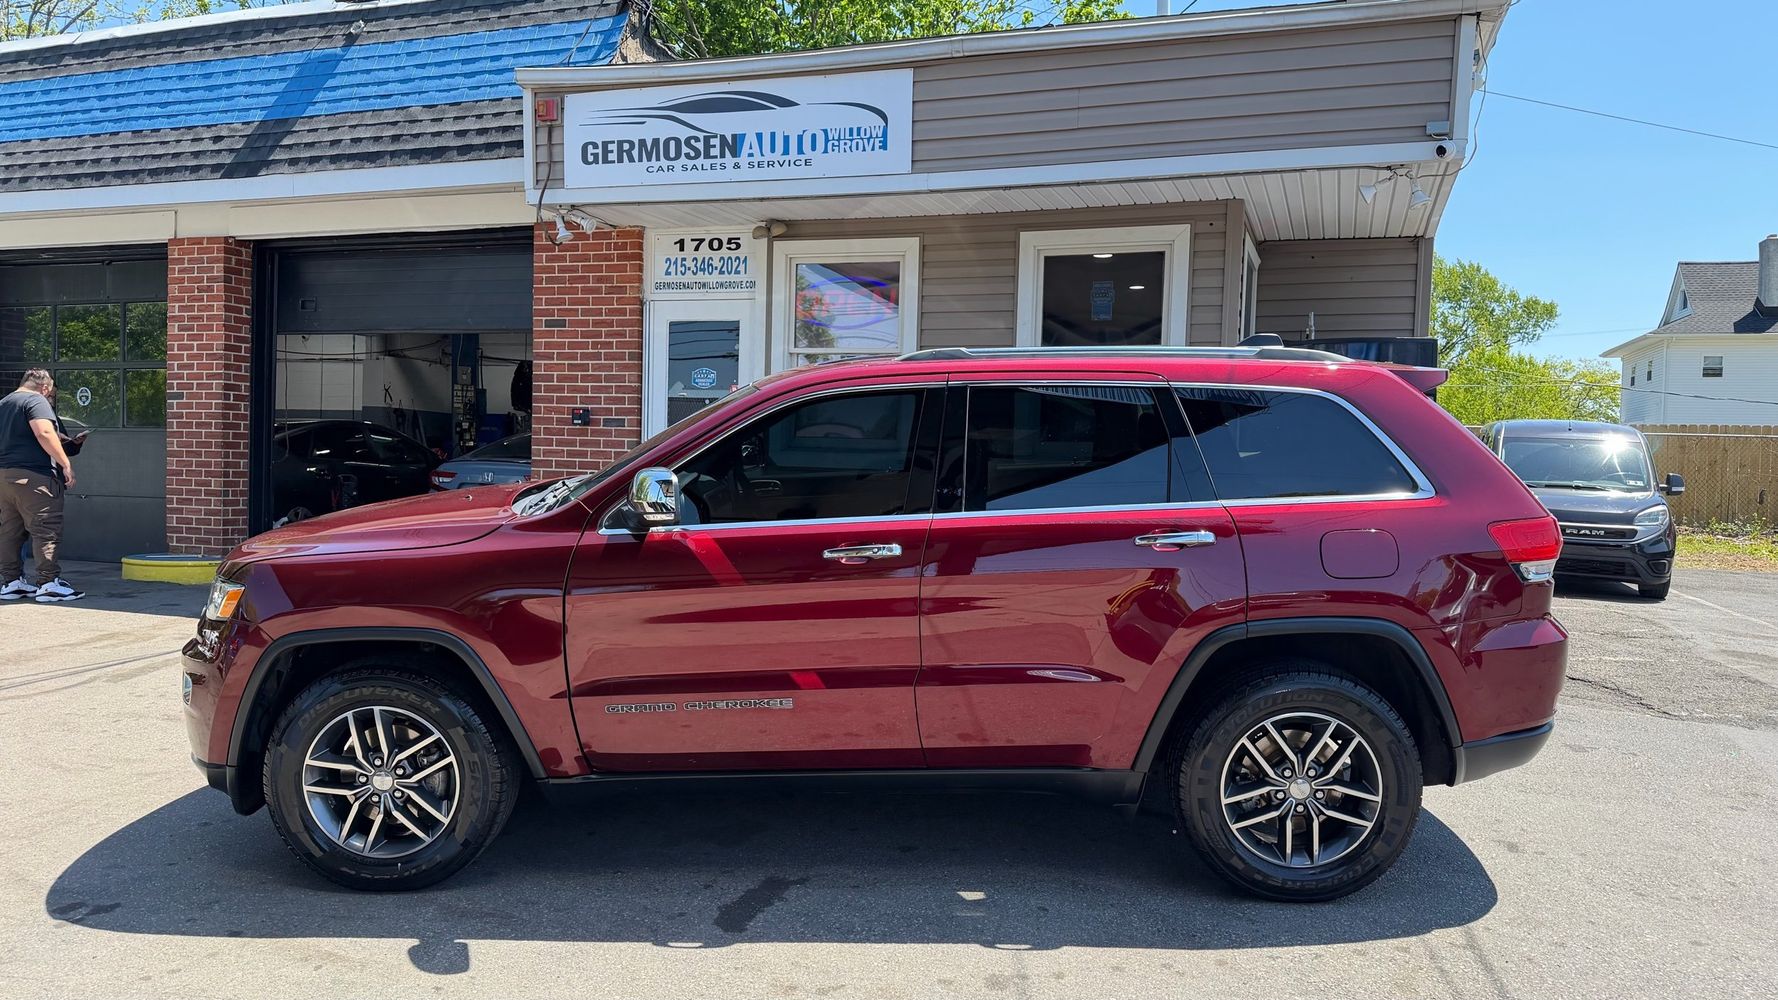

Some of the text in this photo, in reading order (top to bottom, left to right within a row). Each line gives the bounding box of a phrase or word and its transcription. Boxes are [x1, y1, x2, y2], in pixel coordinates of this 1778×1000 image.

[828, 125, 884, 139] WILLOW
[581, 128, 827, 165] GERMOSEN AUTO
[827, 138, 884, 153] GROVE
[645, 158, 813, 174] CAR SALES & SERVICE
[673, 237, 742, 252] 1705
[664, 255, 748, 276] 215-346-2021
[1565, 527, 1605, 536] RAM
[605, 698, 793, 714] GRAND CHEROKEE
